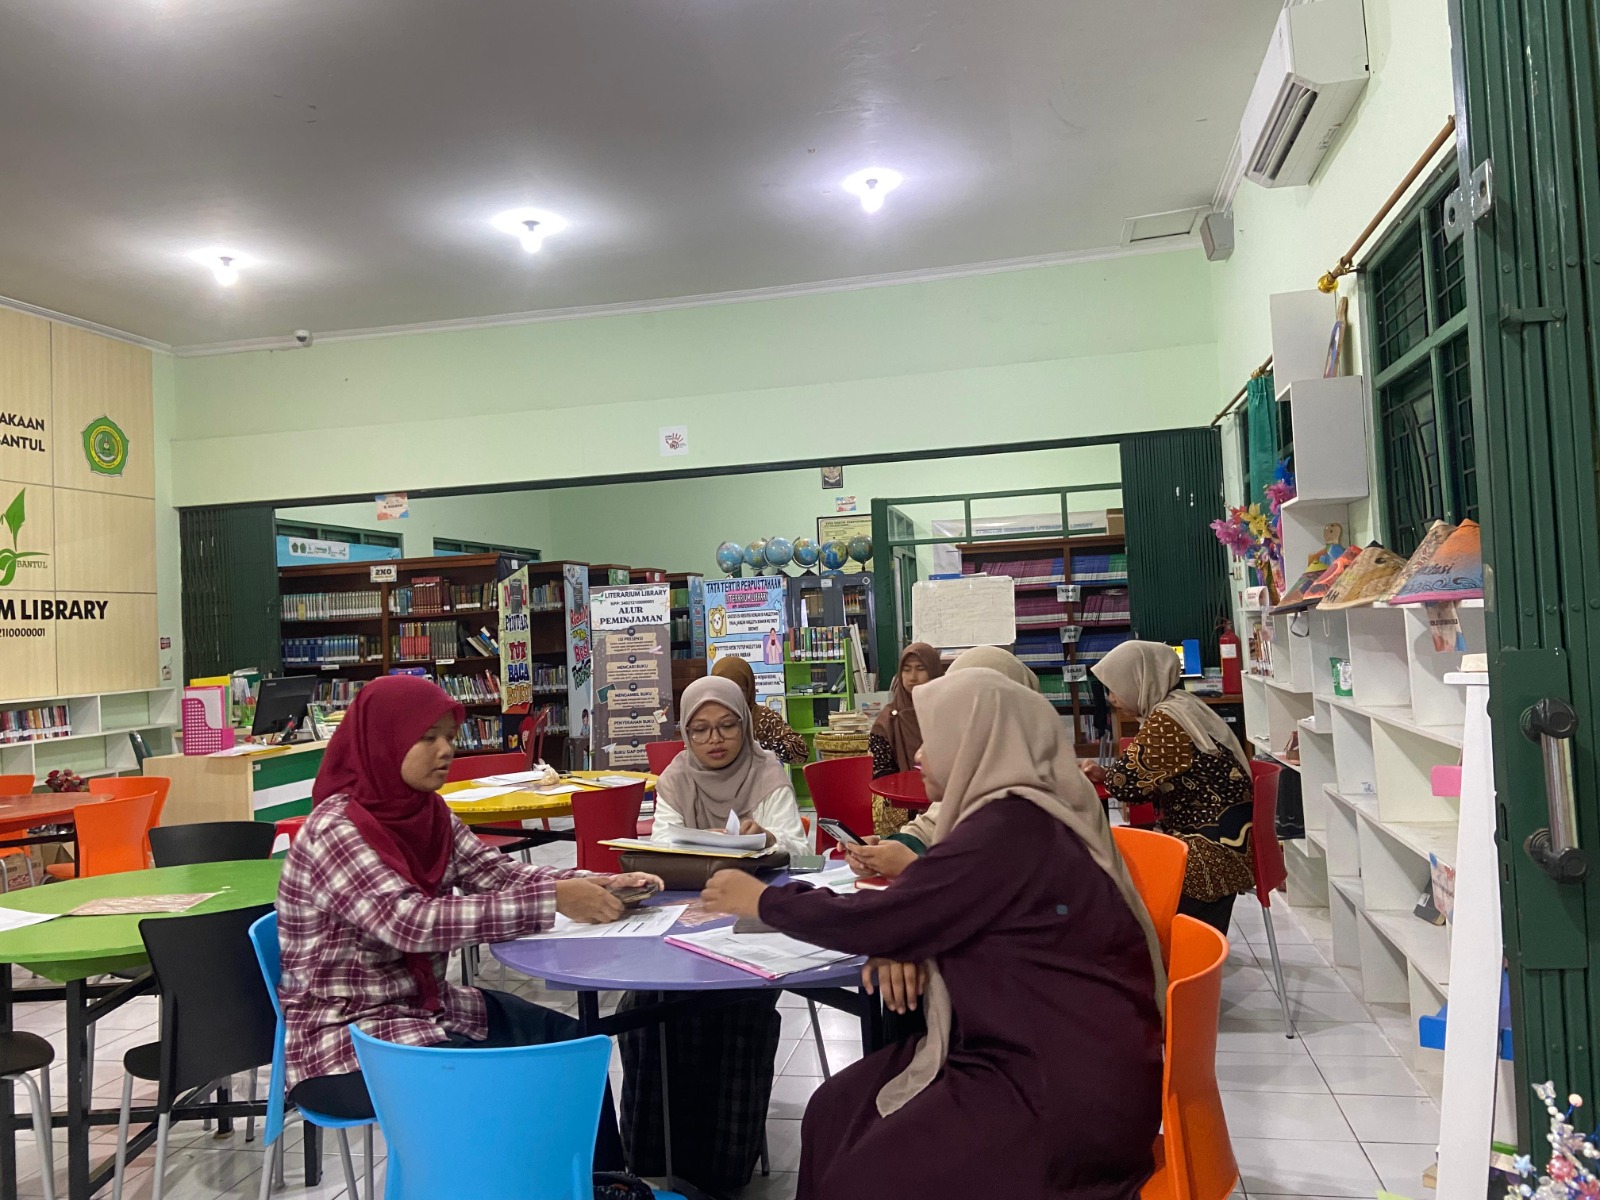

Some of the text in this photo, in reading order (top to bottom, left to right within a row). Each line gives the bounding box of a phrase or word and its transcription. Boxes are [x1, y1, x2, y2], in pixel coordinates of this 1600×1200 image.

[0, 412, 45, 432] AKAAN
[0, 434, 45, 452] ANTUL
[17, 560, 48, 569] BANTUL
[605, 589, 667, 599] LITERARIUM LIBRARY
[706, 578, 782, 594] TATA TERTIB PERPUSTAKAAN
[20, 599, 109, 620] LIBRARY
[618, 606, 644, 615] ALUR
[600, 614, 663, 625] PEMINJAMAN
[508, 640, 528, 661] YUK
[507, 662, 530, 683] BACA
